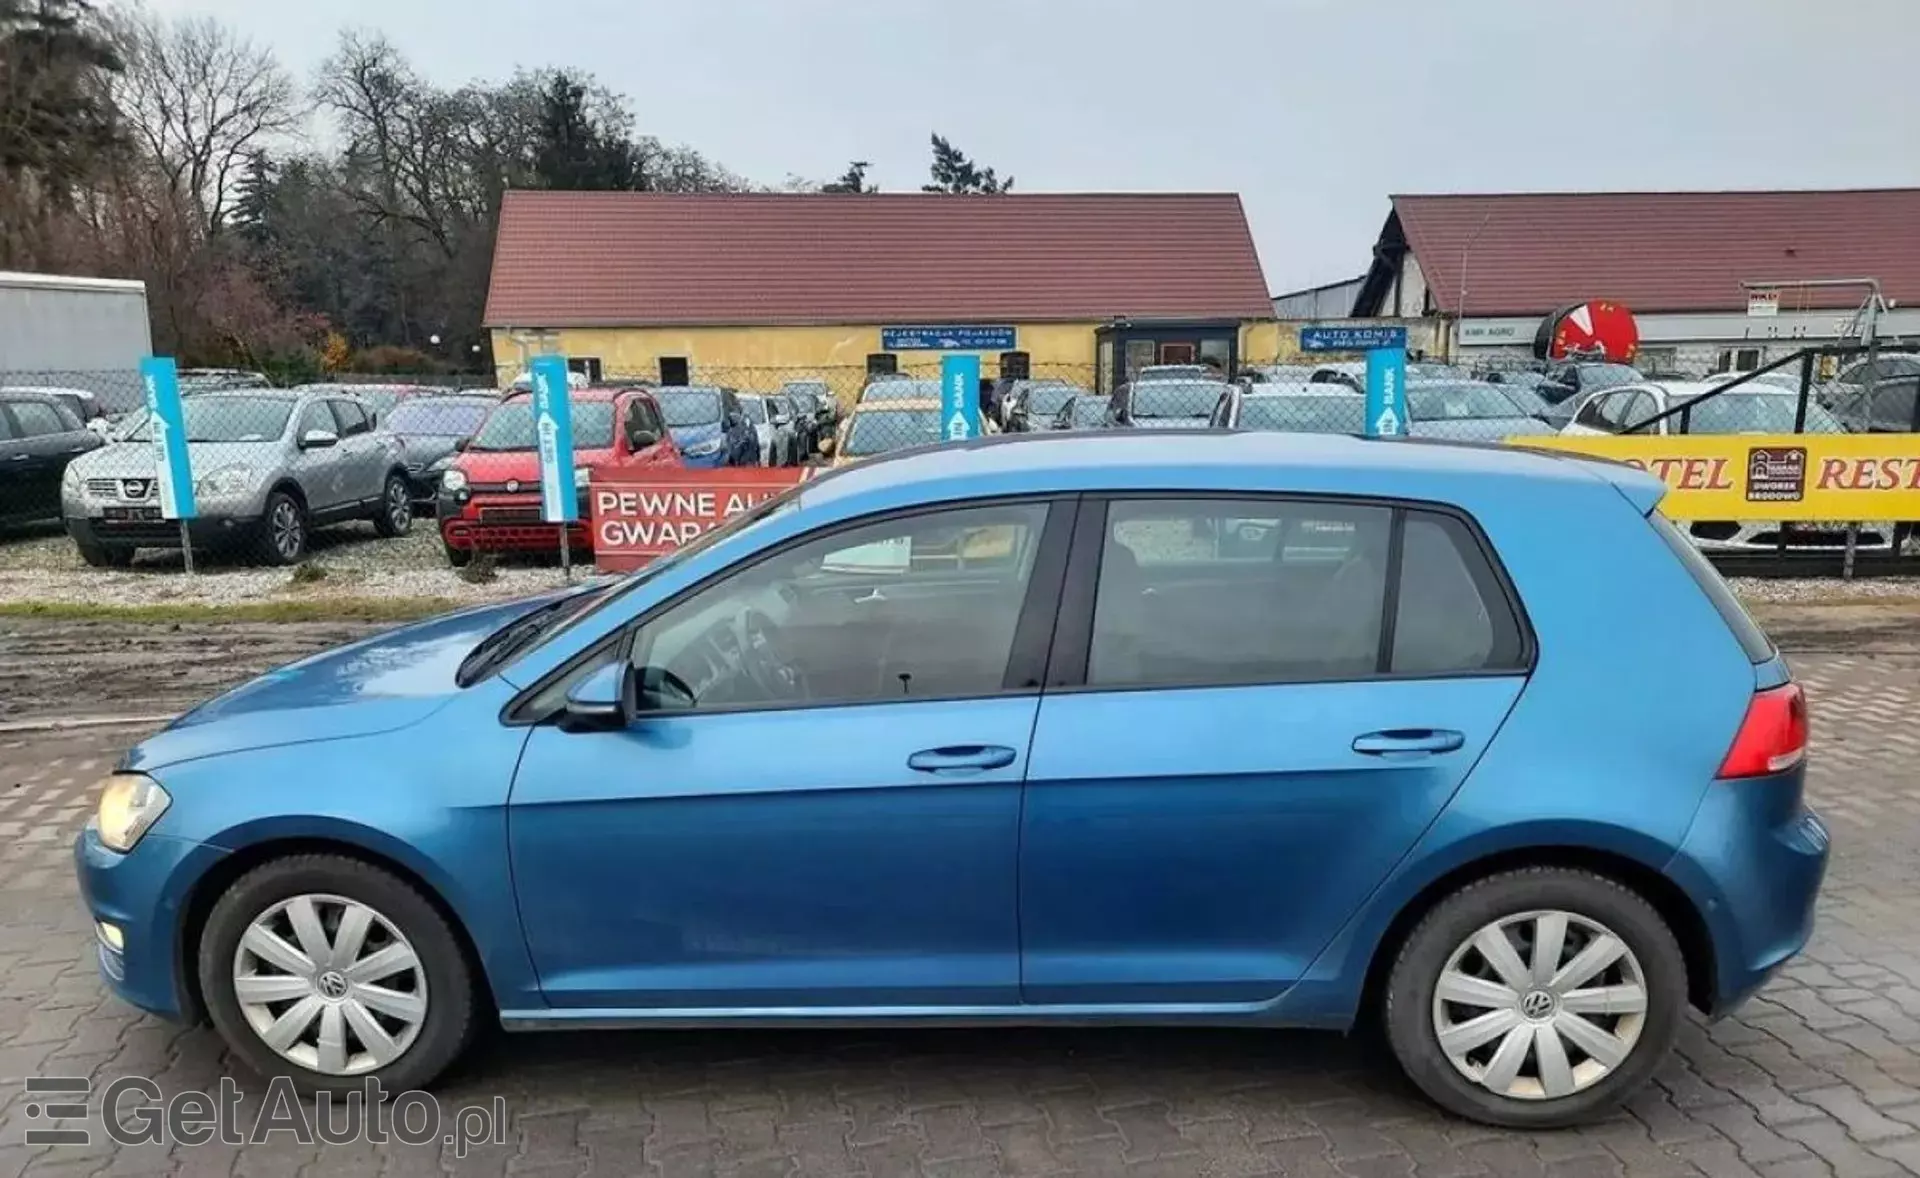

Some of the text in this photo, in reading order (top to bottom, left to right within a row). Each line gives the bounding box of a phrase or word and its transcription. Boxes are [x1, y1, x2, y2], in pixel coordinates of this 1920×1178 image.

[1313, 329, 1398, 339] AUTO KOMIS
[1622, 458, 1735, 489] TEL
[596, 491, 717, 517] PEWNE
